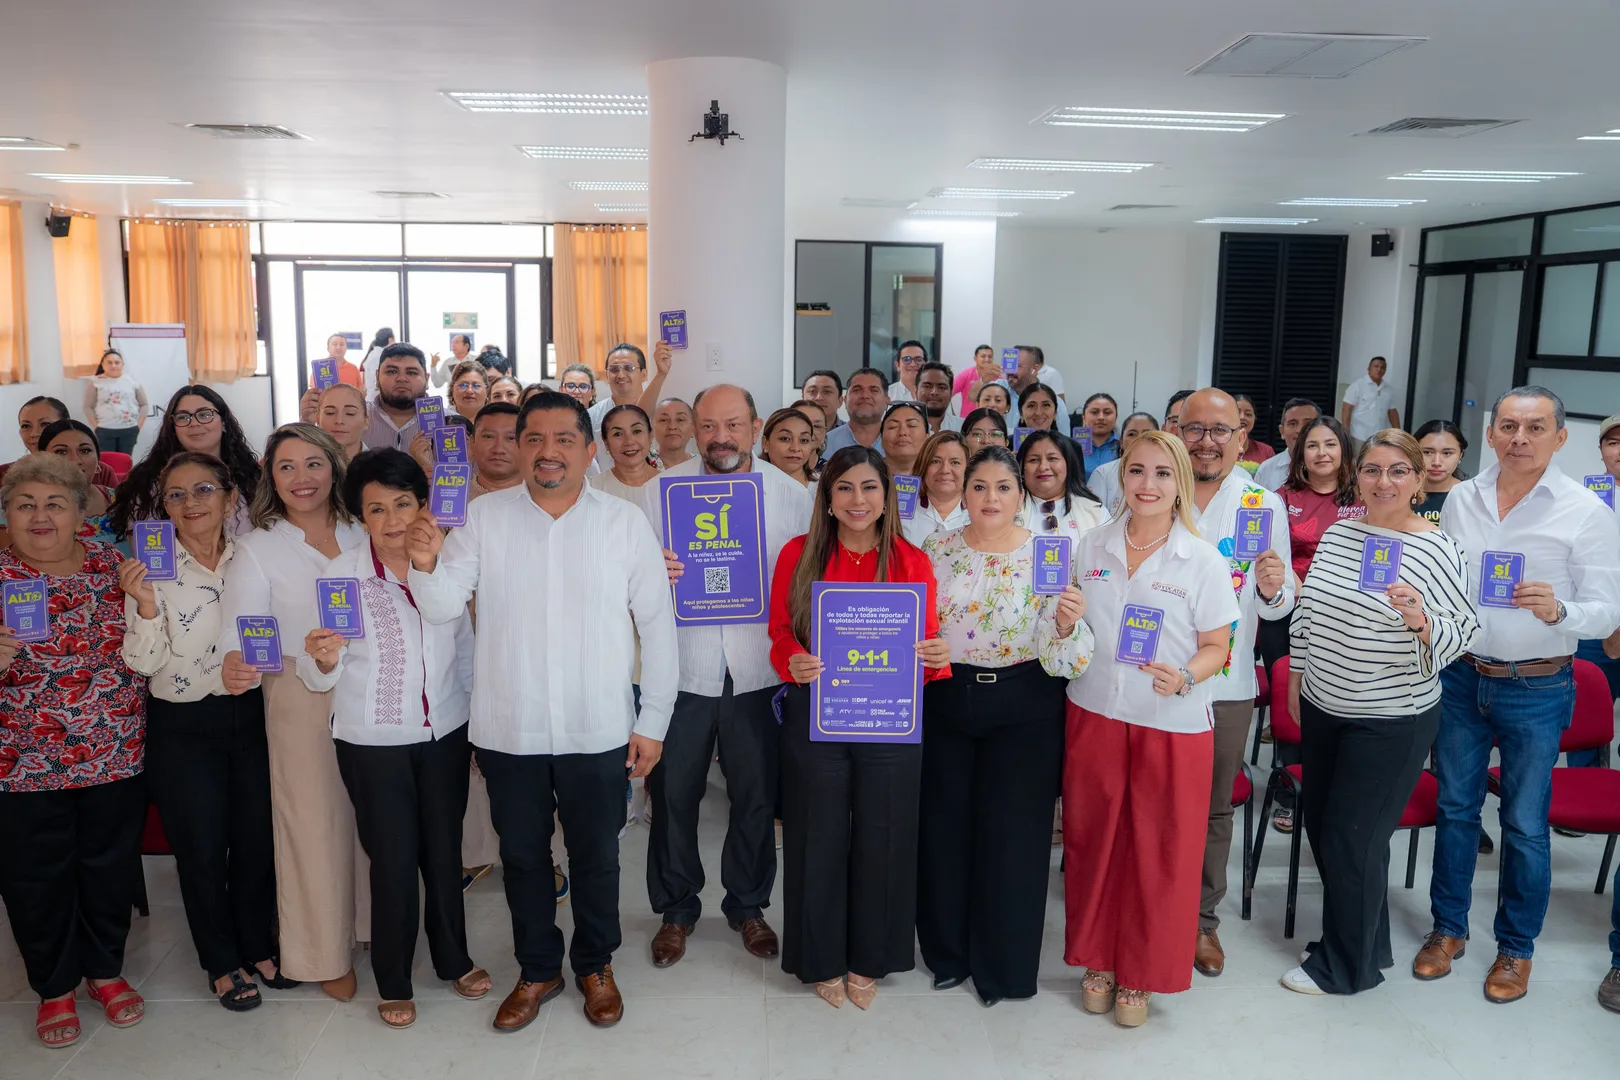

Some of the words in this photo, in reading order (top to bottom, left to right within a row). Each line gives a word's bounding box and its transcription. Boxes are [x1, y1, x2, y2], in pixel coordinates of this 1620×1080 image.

[444, 435, 456, 448] SÍ
[436, 476, 466, 486] ALTO
[694, 503, 732, 540] SÍ
[1424, 510, 1440, 520] GO
[1247, 518, 1262, 531] SÍ
[146, 532, 163, 546] SÍ
[689, 542, 702, 551] ES
[706, 540, 742, 549] PENAL
[1045, 547, 1060, 561] SÍ
[1374, 547, 1390, 561] SÍ
[1494, 562, 1511, 576] SÍ
[8, 591, 42, 604] ALTO
[331, 589, 347, 605] SÍ
[1126, 617, 1157, 630] ALTO
[244, 628, 275, 637] ALTO
[847, 649, 888, 666] 9-1-1
